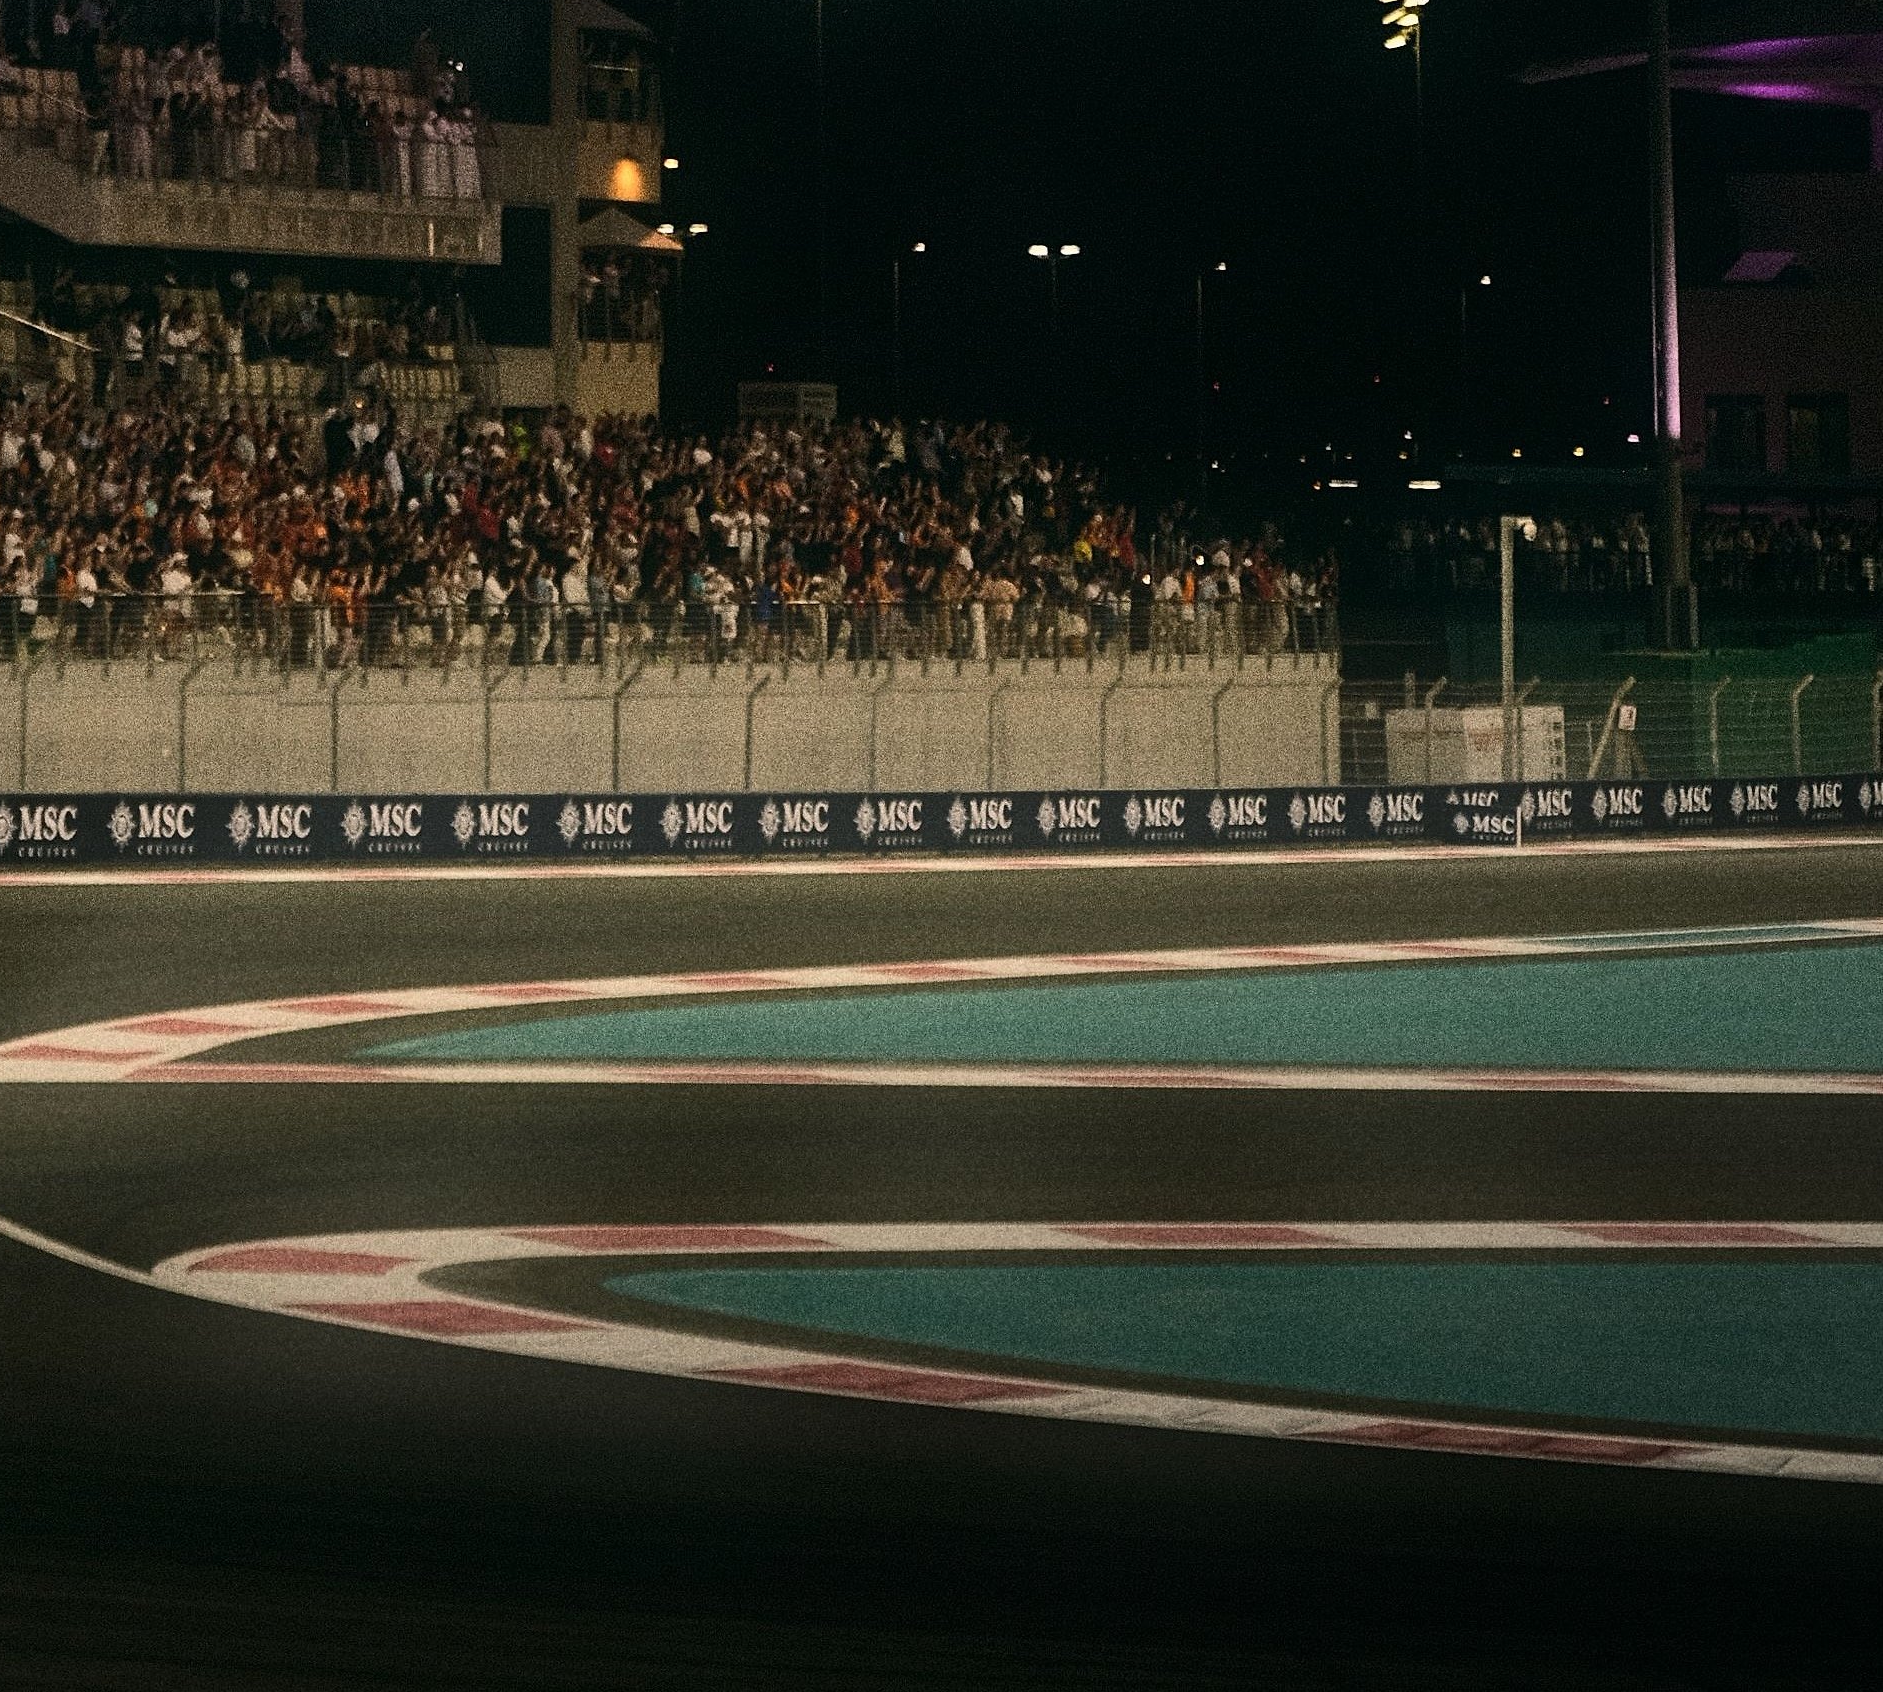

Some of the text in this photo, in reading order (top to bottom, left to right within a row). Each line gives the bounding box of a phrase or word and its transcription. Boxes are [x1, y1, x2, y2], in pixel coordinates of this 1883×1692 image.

[1308, 795, 1345, 823] MSC
[1387, 794, 1423, 821] MSC
[1538, 790, 1571, 816] MSC
[1609, 788, 1642, 814] MSC
[1679, 787, 1711, 812] MSC
[1747, 785, 1777, 810] MSC
[1812, 783, 1842, 808] MSC
[19, 806, 77, 840] MSC
[139, 804, 194, 838] MSC
[257, 805, 311, 838] MSC
[370, 804, 421, 836] MSC
[479, 803, 528, 836] MSC
[584, 803, 632, 834] MSC
[686, 802, 732, 833] MSC
[783, 802, 828, 832] MSC
[879, 801, 922, 831] MSC
[970, 800, 1012, 829] MSC
[1059, 798, 1100, 828] MSC
[1145, 797, 1184, 826] MSC
[1229, 797, 1266, 825] MSC
[1473, 814, 1515, 835] MSC
